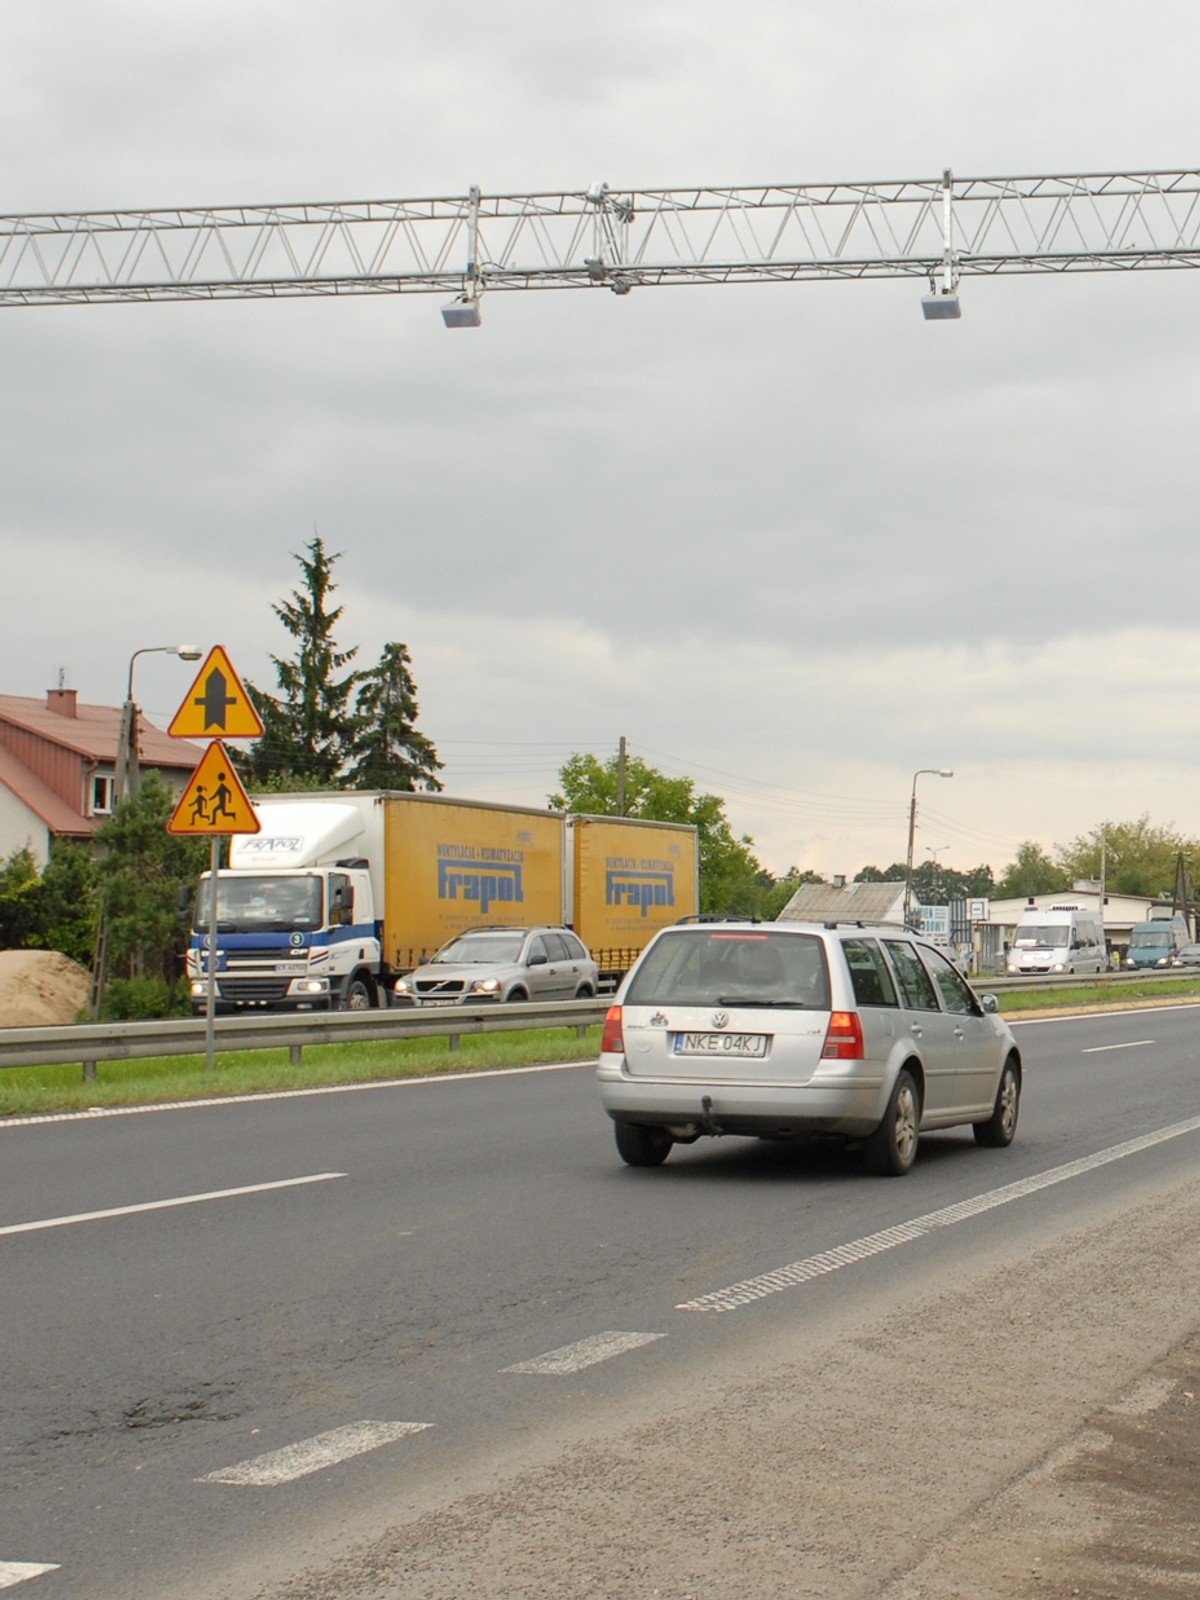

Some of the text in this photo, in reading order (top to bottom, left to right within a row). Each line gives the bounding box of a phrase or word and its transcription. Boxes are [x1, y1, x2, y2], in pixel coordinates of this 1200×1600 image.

[294, 934, 301, 944] 3
[685, 1034, 762, 1052] NKE 04KJ
